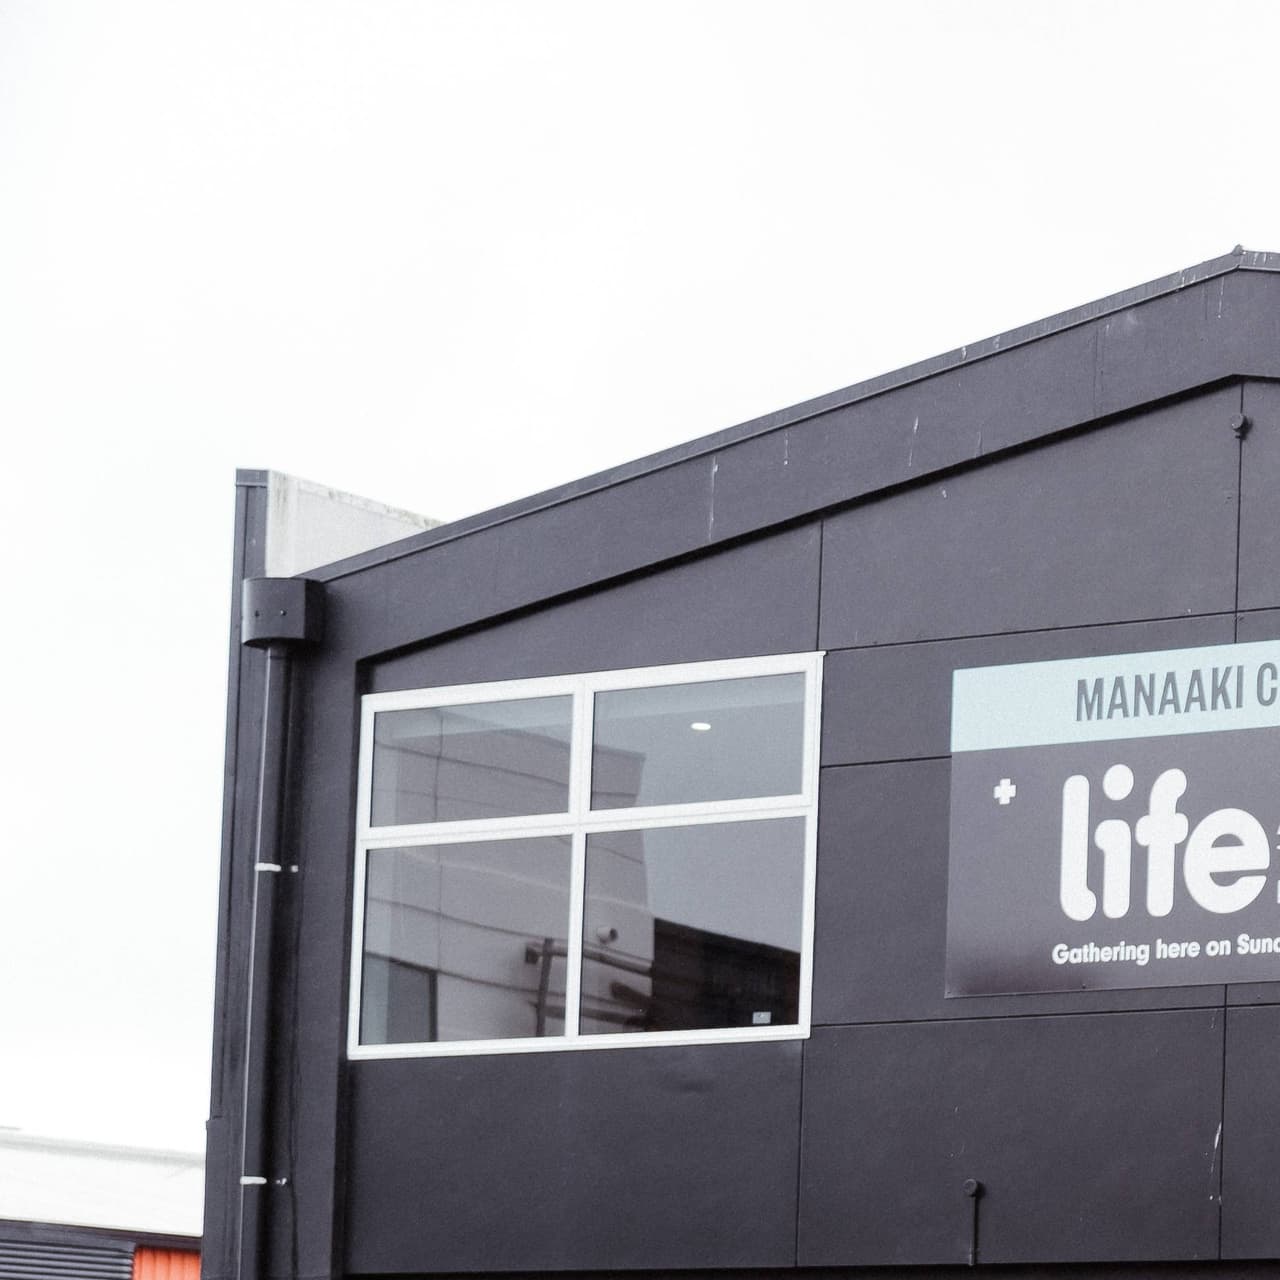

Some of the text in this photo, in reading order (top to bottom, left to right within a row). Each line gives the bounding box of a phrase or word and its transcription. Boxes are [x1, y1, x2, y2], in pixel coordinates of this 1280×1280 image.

[1076, 665, 1244, 721] MANAAKI
[1060, 764, 1270, 921] life
[1052, 940, 1150, 966] Gathering
[1156, 938, 1201, 959] here
[1205, 939, 1232, 956] on
